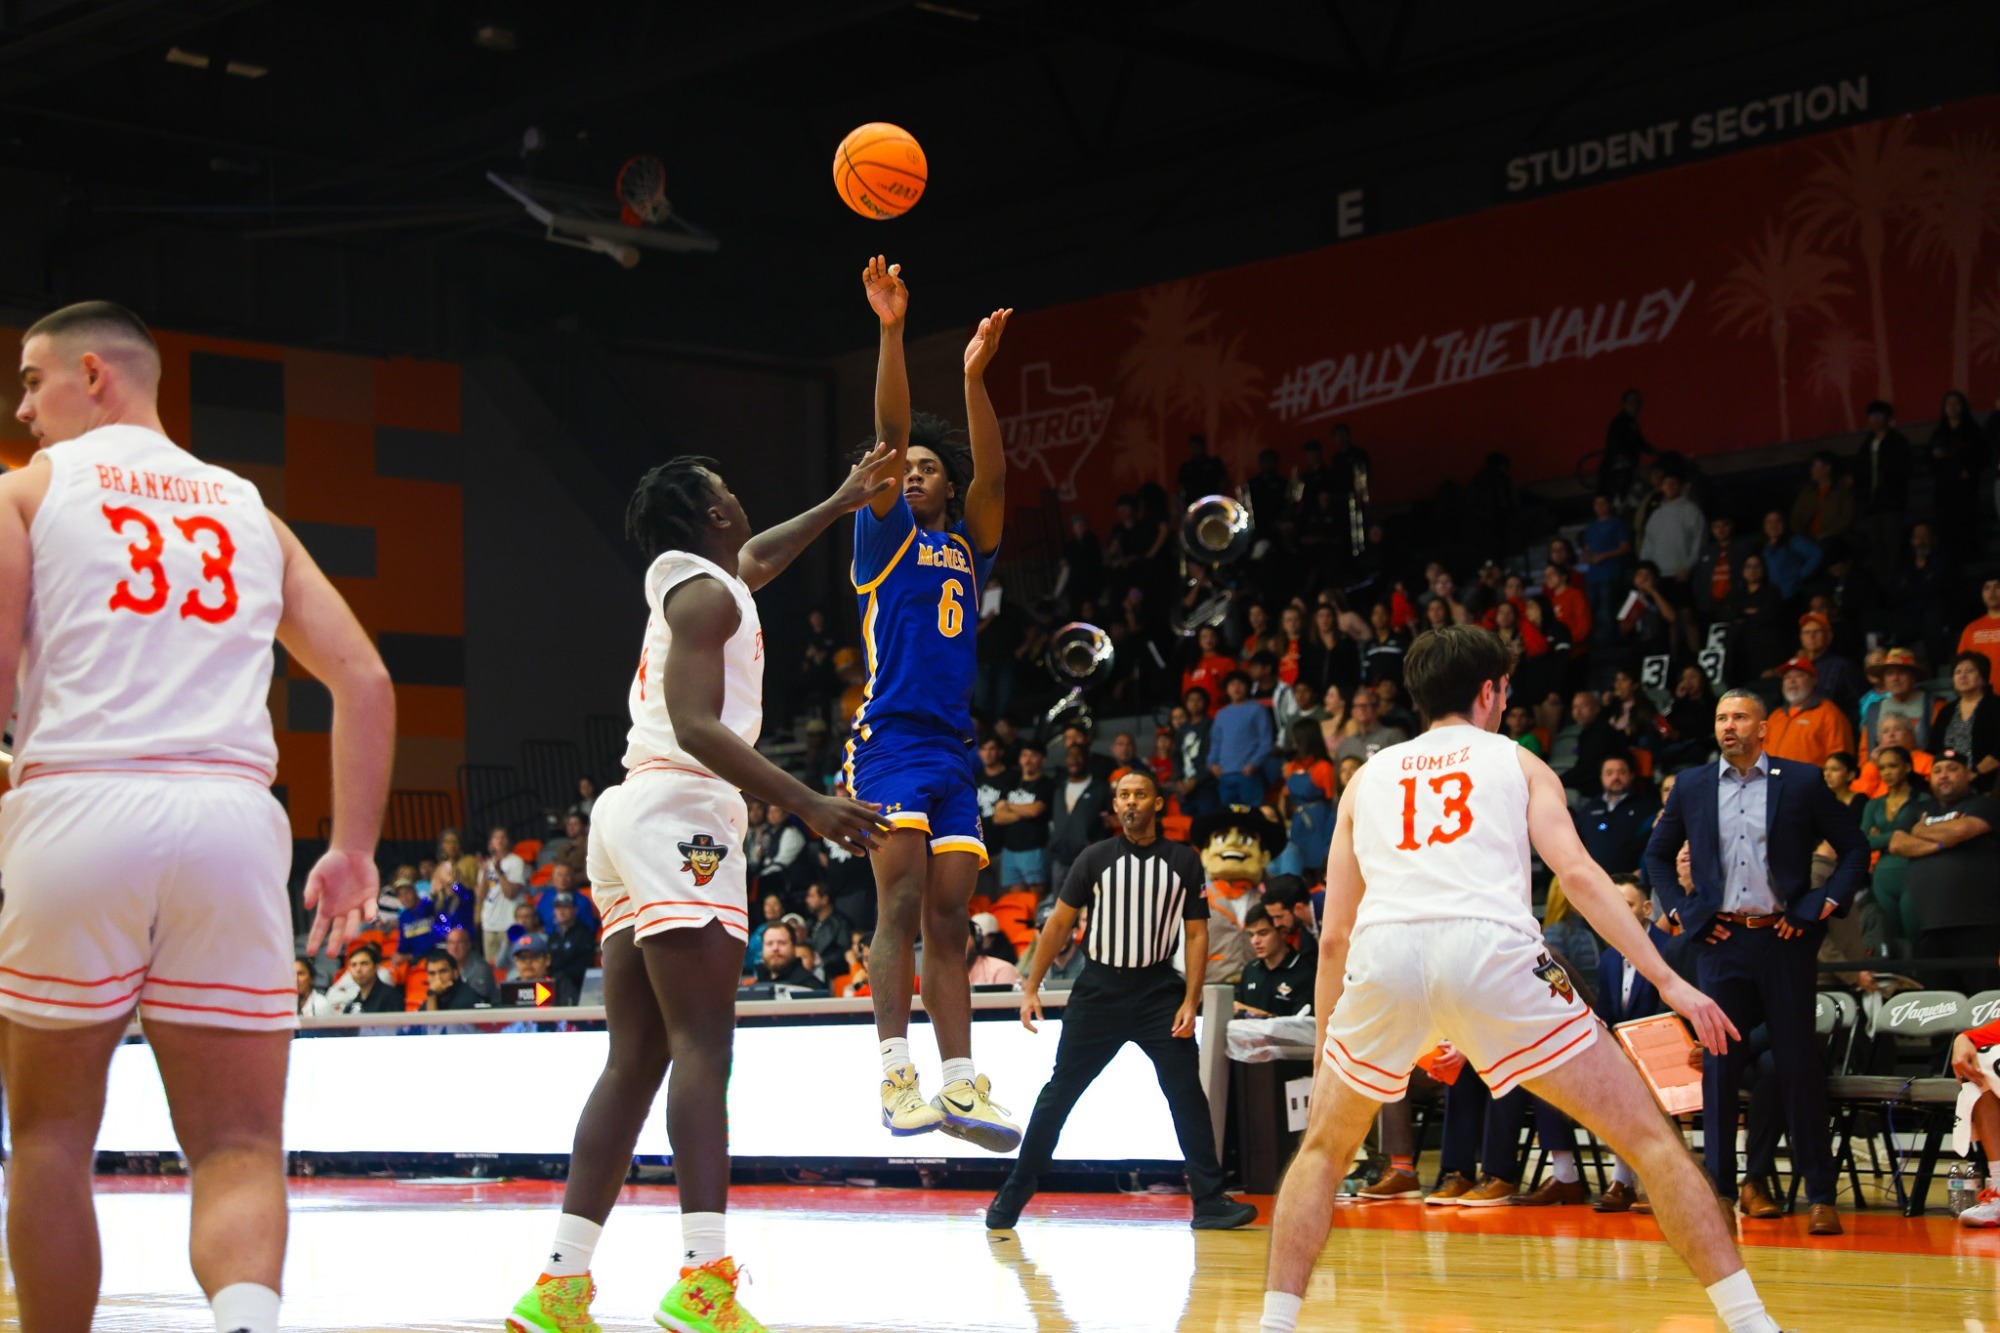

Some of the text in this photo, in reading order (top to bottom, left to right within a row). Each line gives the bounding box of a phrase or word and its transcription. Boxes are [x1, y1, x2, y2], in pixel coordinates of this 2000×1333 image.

[1505, 74, 1870, 192] STUDENT SECTION
[1337, 189, 1364, 238] E
[1268, 279, 1695, 423] #RALLY THE VALLEY
[96, 464, 229, 506] BRANKOVIC
[101, 502, 240, 625] 33
[937, 577, 964, 639] 6
[1645, 658, 1664, 688] 3
[1401, 745, 1472, 772] GOMEZ
[1395, 771, 1475, 851] 13
[1890, 1000, 1958, 1027] Vaqueros
